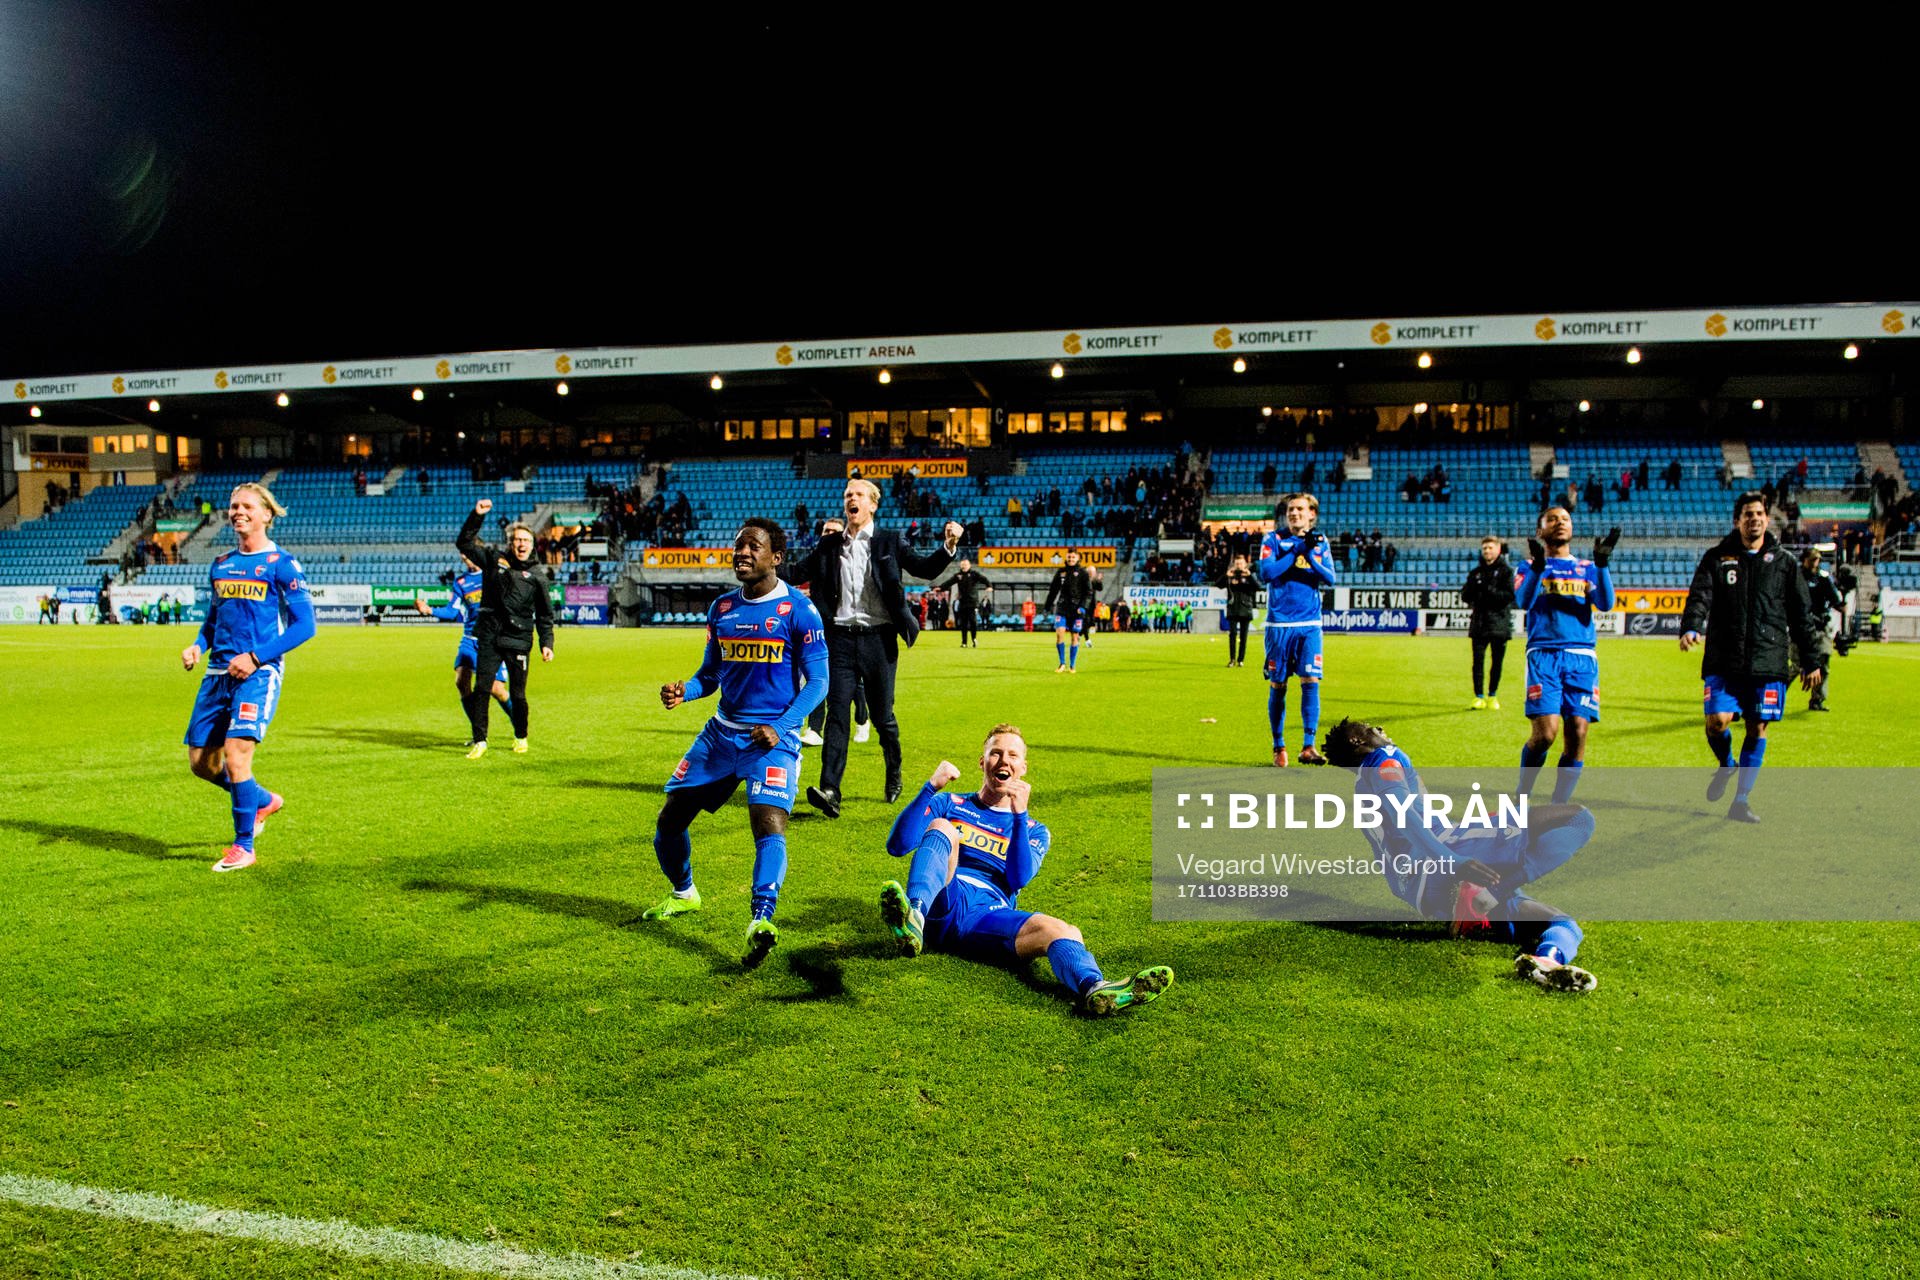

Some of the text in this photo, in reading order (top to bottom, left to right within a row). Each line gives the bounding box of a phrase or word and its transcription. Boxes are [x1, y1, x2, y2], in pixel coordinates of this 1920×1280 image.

[1562, 320, 1643, 335] KOMPLETT
[1733, 317, 1818, 332] KOMPLETT
[1238, 330, 1313, 344] KOMPLETT
[1397, 325, 1475, 339] KOMPLETT
[1086, 335, 1158, 350] KOMPLETT
[797, 345, 916, 361] KOMPLETT ARENA
[454, 362, 512, 375] KOMPLETT
[575, 357, 635, 370] KOMPLETT
[231, 372, 283, 385] KOMPLETT
[340, 367, 394, 380] KOMPLETT
[30, 383, 77, 395] KOMPLETT
[128, 377, 177, 390] KOMPLETT
[995, 408, 1003, 425] C
[922, 463, 964, 475] JOTUN
[659, 553, 700, 565] JOTUN
[997, 552, 1044, 564] JOTUN
[1726, 569, 1737, 585] 6
[222, 583, 265, 598] JOTUN
[1129, 586, 1210, 598] GJERMUNDSEN
[1354, 591, 1386, 608] EKTE
[1389, 591, 1422, 608] VARE
[1654, 595, 1687, 609] JOT
[1322, 611, 1376, 630] ndefjords
[729, 643, 781, 659] JOTUN
[965, 831, 1007, 857] JOTU
